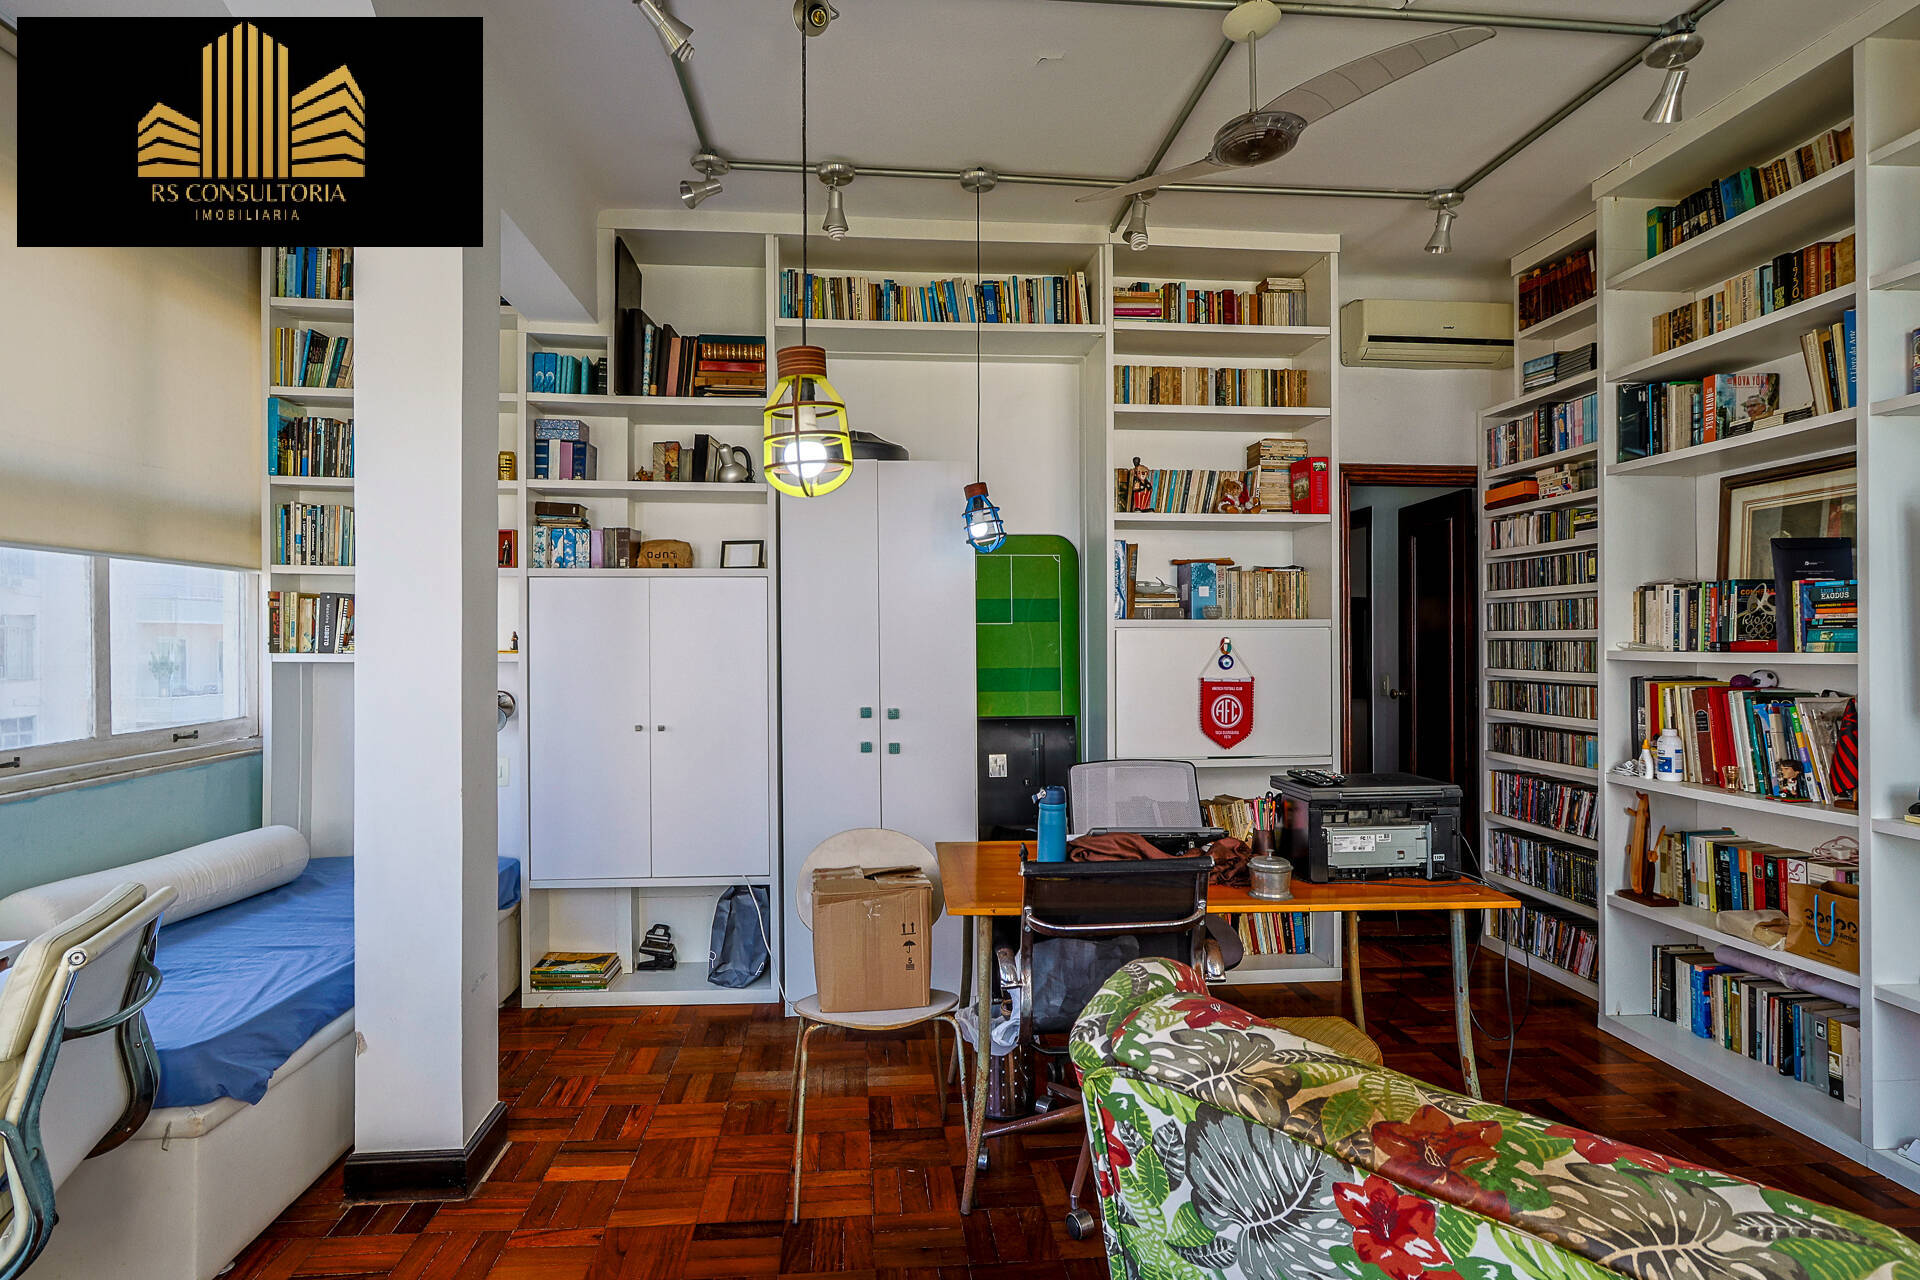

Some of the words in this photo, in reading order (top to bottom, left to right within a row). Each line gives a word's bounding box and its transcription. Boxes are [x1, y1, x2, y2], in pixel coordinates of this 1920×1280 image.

[1705, 393, 1715, 412] NOVA
[647, 551, 678, 559] LUPO
[1216, 699, 1238, 724] AFC
